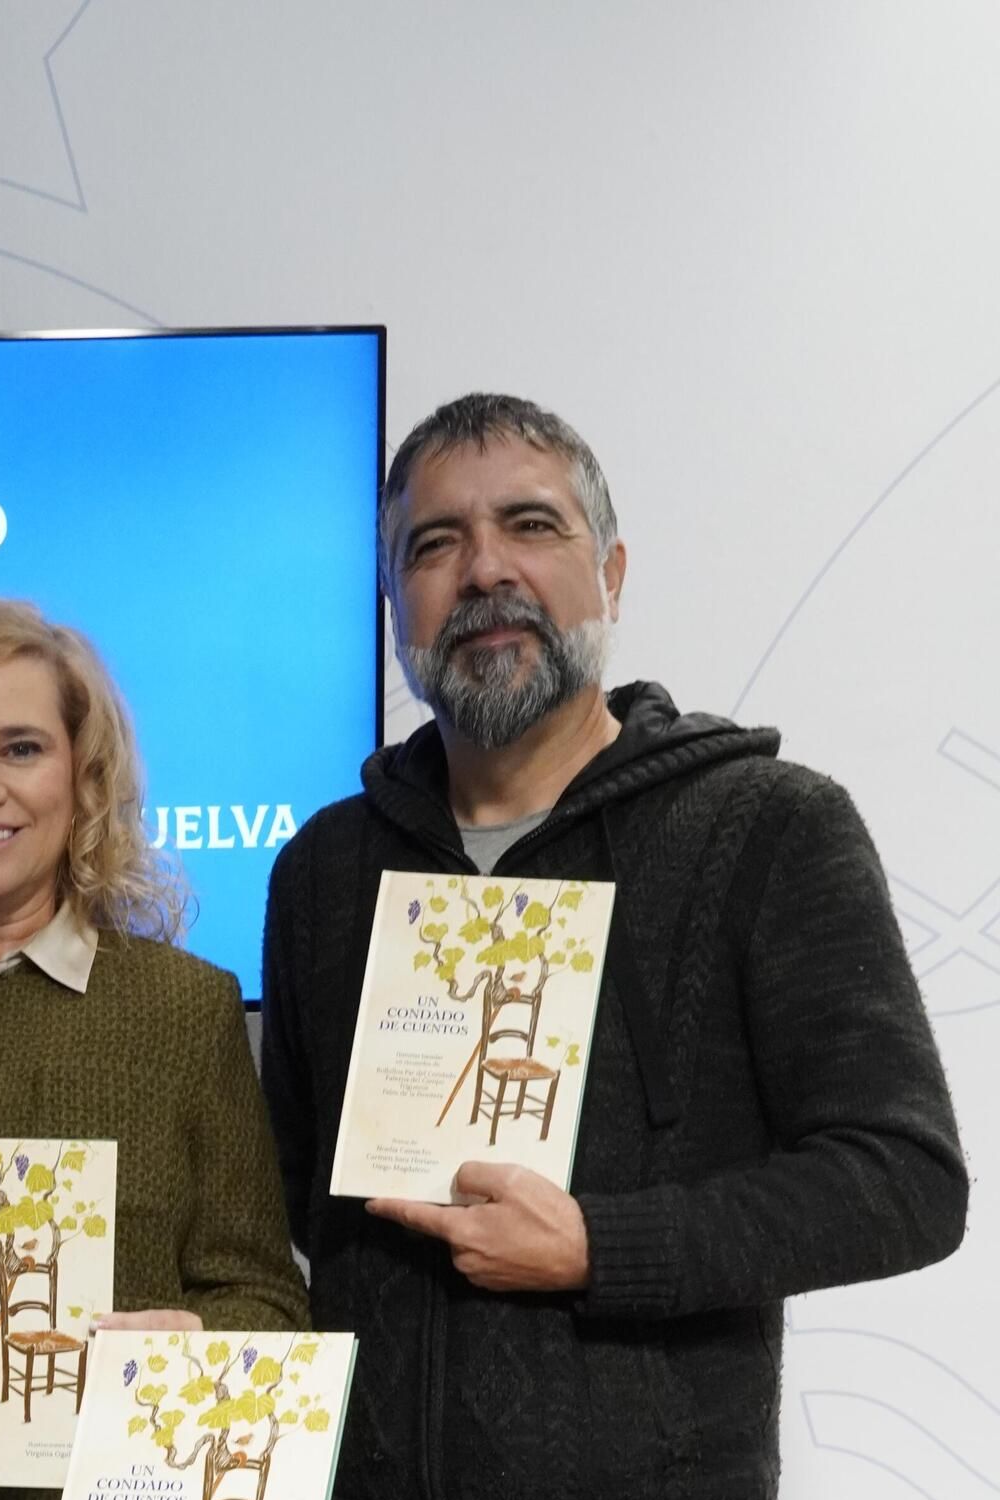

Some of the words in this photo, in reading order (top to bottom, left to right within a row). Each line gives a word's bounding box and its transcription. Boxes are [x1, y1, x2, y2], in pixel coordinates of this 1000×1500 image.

[142, 804, 298, 849] UELVA
[417, 995, 439, 1007] UN
[387, 1007, 465, 1021] CONDADO
[379, 1020, 400, 1031] DE
[402, 1022, 468, 1035] CUENTOS
[131, 1464, 155, 1476] UN
[97, 1479, 183, 1491] CONDADO
